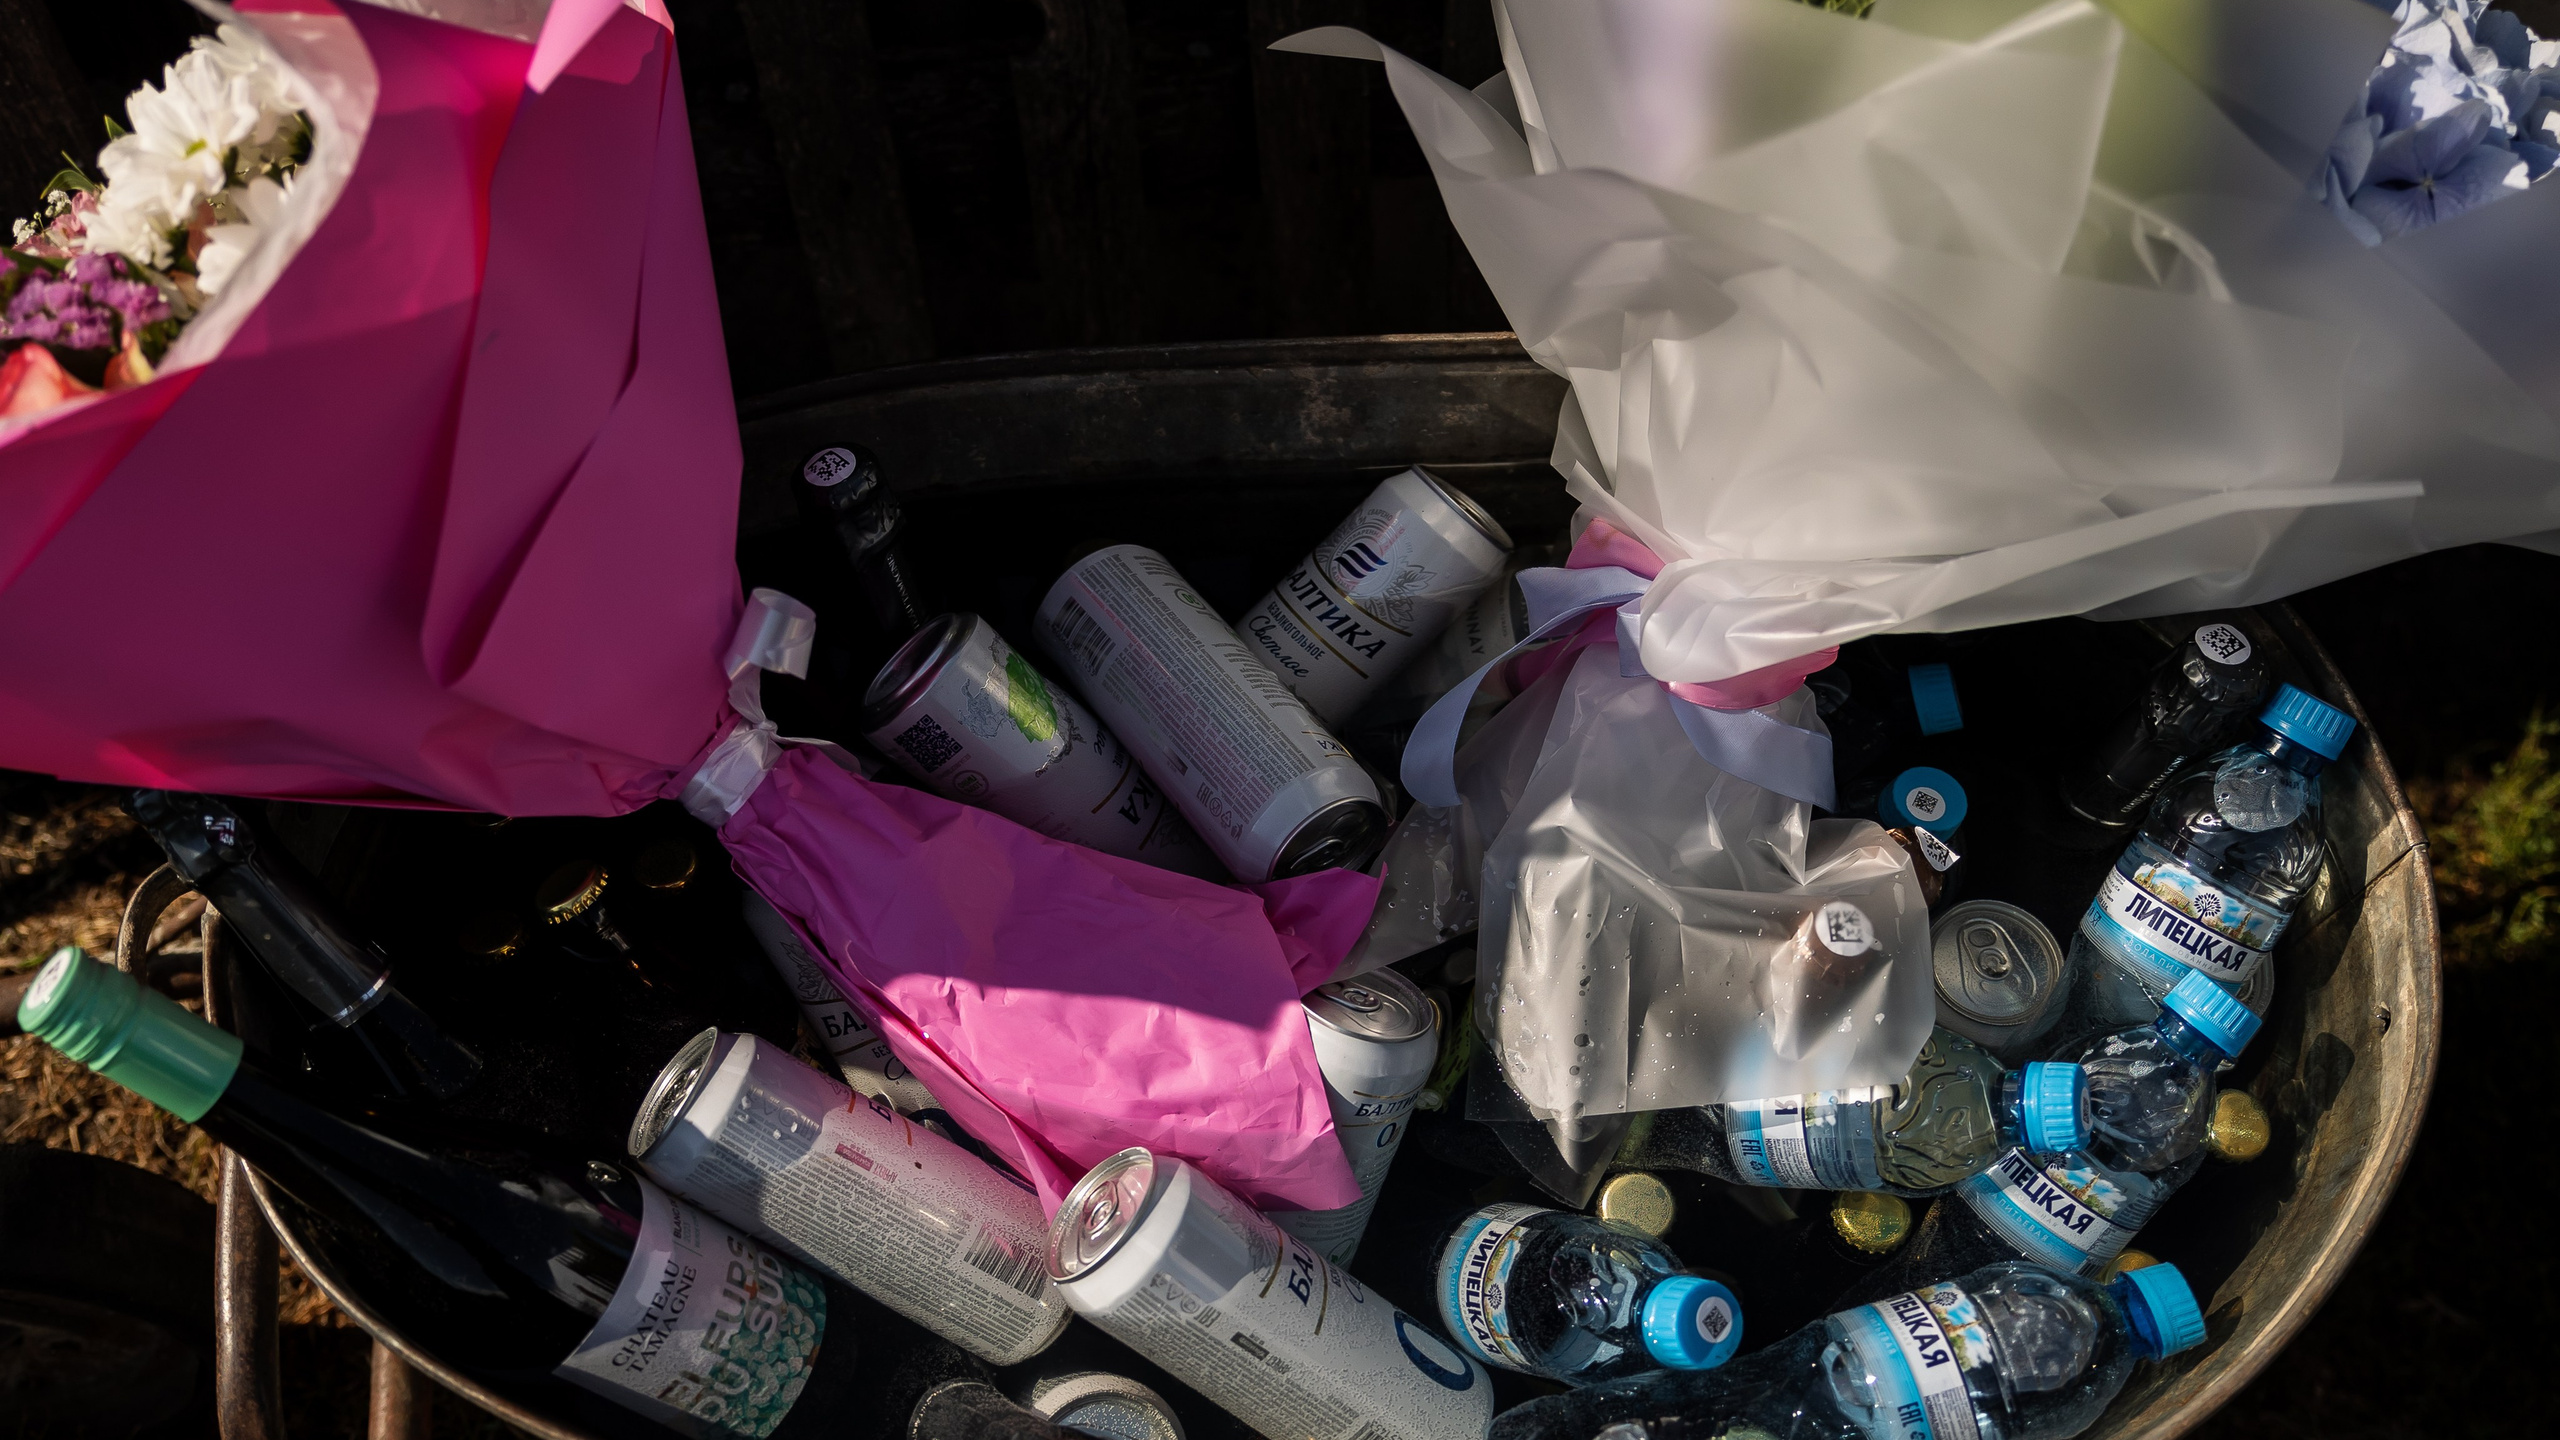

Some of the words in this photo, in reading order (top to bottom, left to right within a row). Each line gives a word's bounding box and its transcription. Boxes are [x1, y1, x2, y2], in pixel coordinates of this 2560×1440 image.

[1248, 615, 1309, 678] Светлое
[1266, 601, 1326, 660] БЕЗАЛКОГОЛЬНОЕ
[2124, 891, 2250, 973] ЛИПЕЦКАЯ
[2155, 957, 2187, 978] ПИТЬ
[1999, 1150, 2096, 1236] ИПЕЦКАЯ
[612, 1259, 680, 1368] CHATEAU
[626, 1266, 697, 1374] TAMAGNE
[1465, 1230, 1503, 1355] ЛИПЕЦКАЯ
[1890, 1290, 1950, 1373] ПЕЦКАЯ
